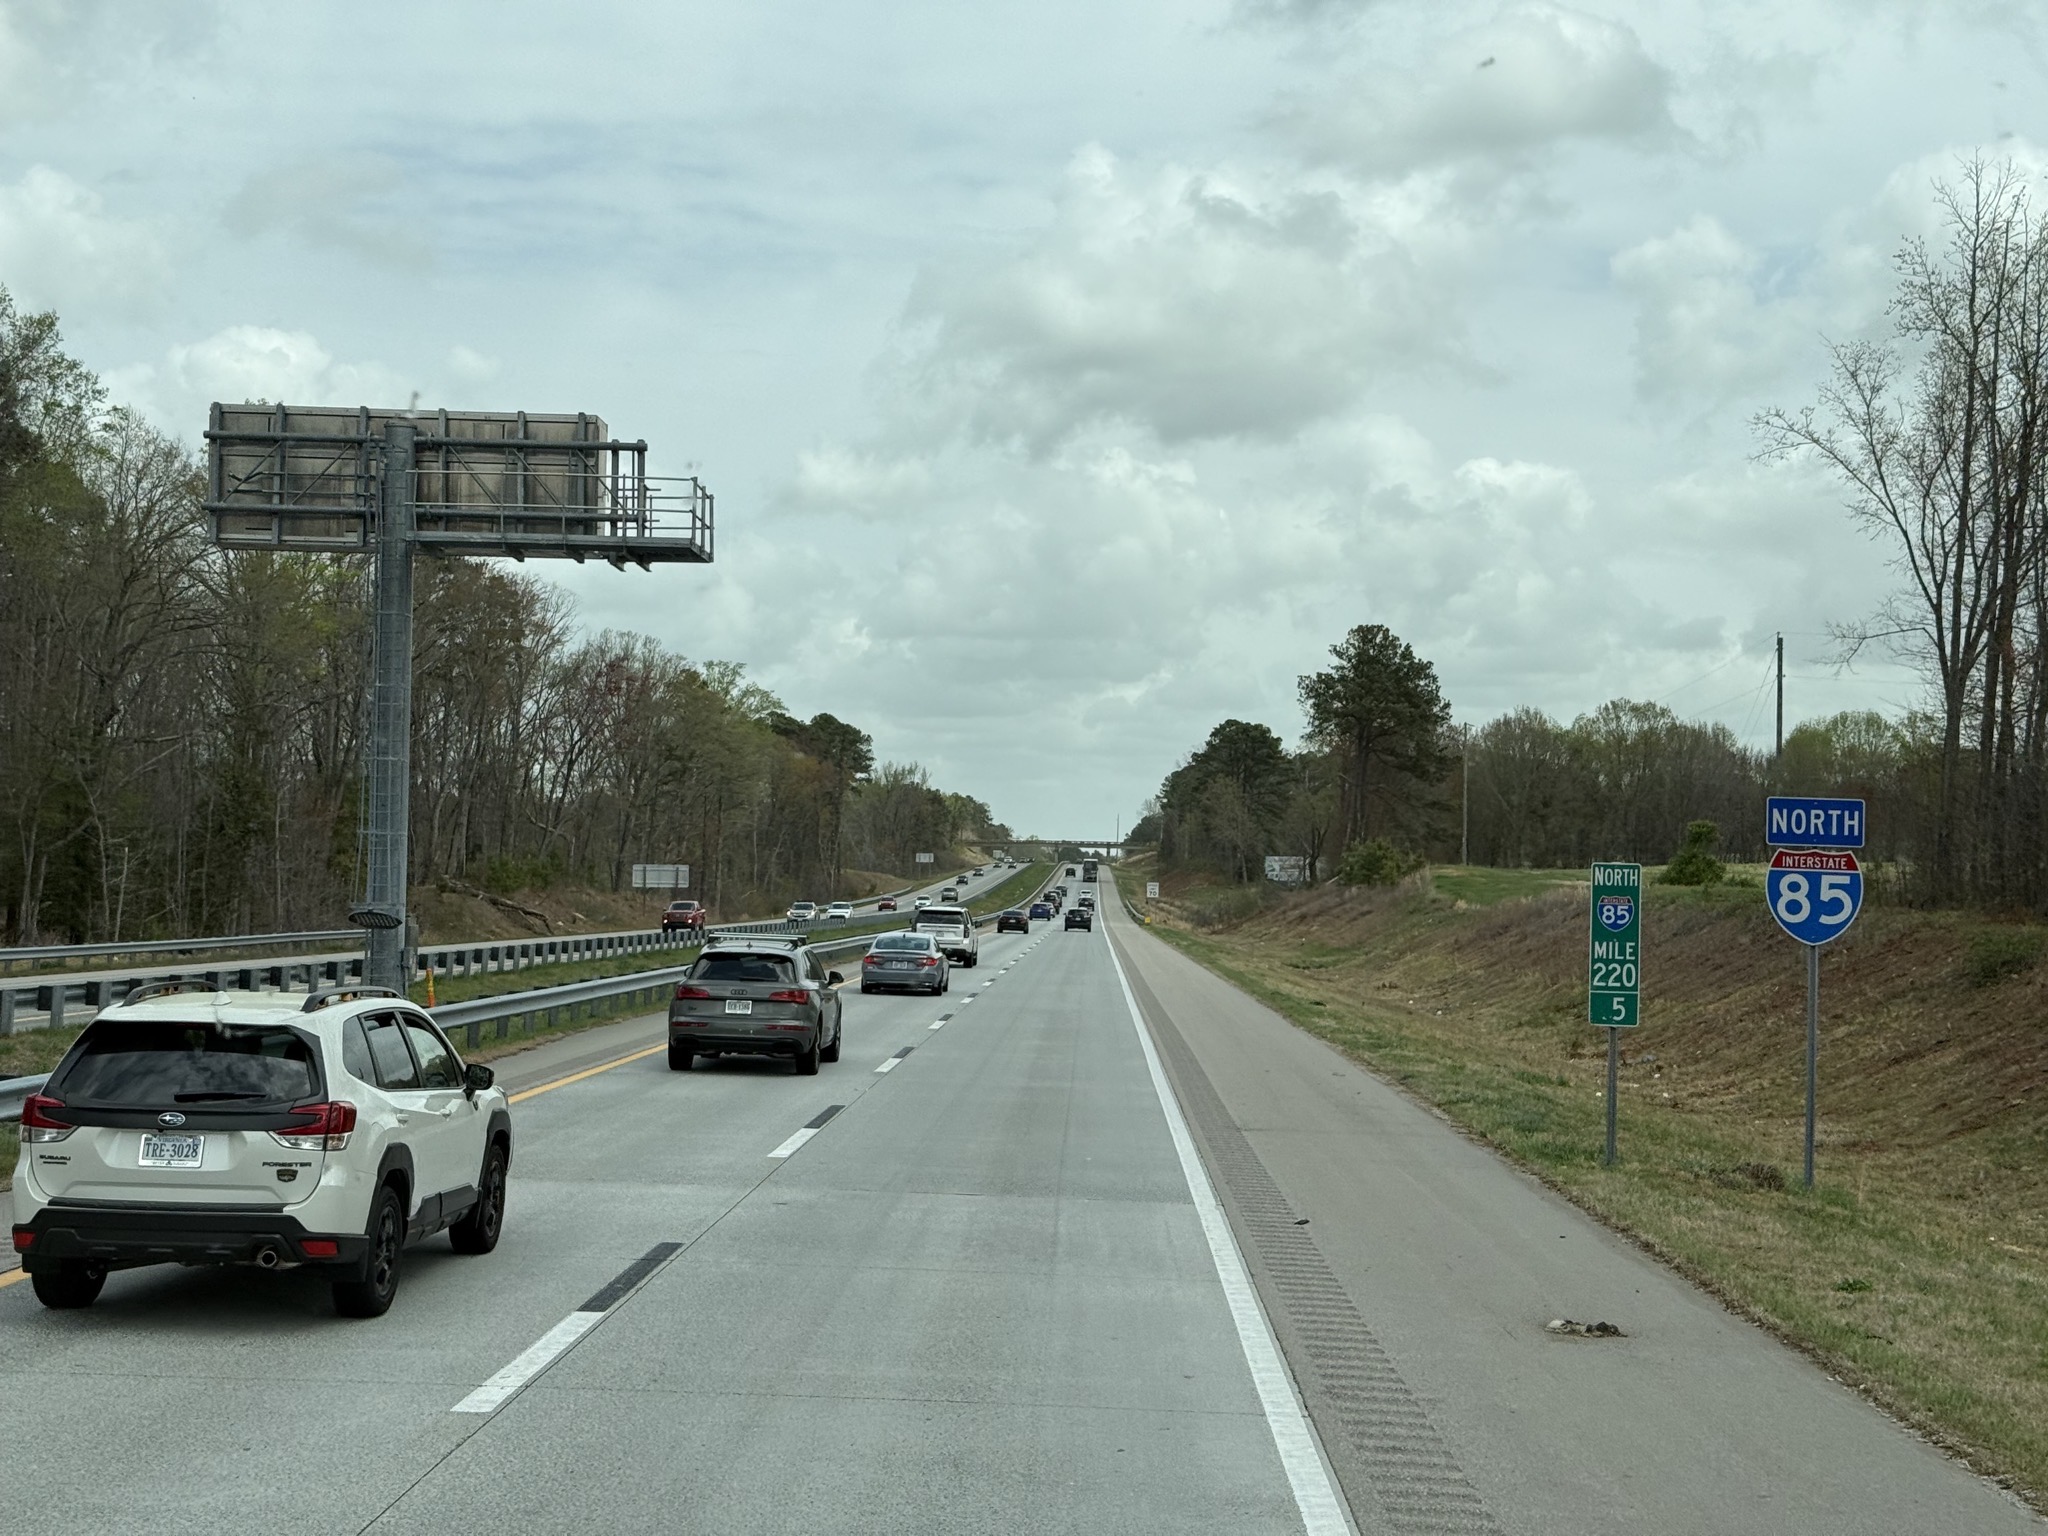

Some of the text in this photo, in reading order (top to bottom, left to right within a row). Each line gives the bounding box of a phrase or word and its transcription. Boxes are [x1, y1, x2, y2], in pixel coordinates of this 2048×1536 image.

[1772, 808, 1859, 836] NORTH
[1782, 855, 1848, 870] INTERSTATE
[1594, 866, 1638, 887] NORTH
[1777, 874, 1852, 924] 85
[1602, 905, 1629, 924] 85
[1594, 942, 1636, 960] MILE
[1592, 962, 1636, 988] 220
[145, 1142, 199, 1158] TRE-3028
